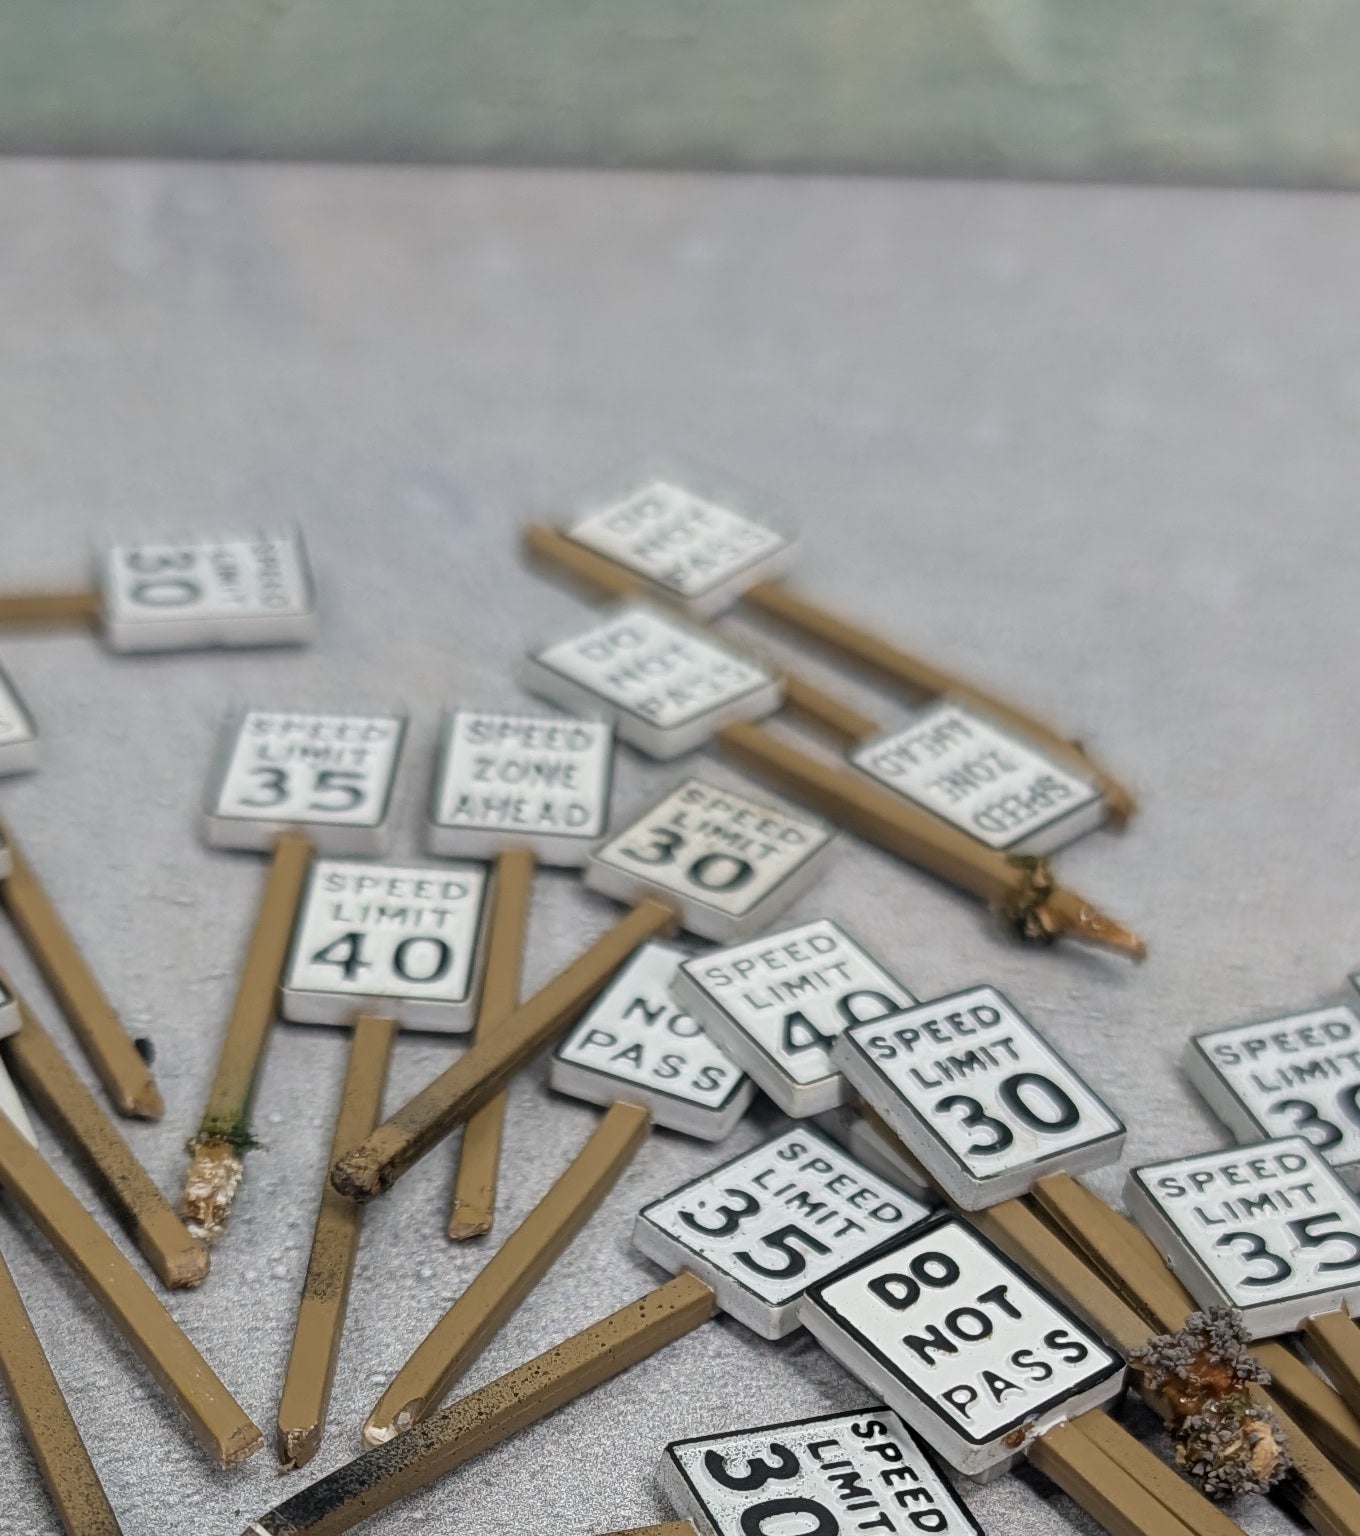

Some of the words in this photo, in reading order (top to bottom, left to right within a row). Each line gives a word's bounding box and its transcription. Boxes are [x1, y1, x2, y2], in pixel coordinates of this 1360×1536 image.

[580, 630, 643, 662] DO
[248, 716, 392, 745] SPEED
[257, 741, 371, 767] LIMIT
[465, 718, 594, 752] SPEED
[239, 767, 365, 811] 35
[474, 757, 582, 788] ZONE
[926, 750, 1018, 802] ZONE
[453, 791, 591, 829] AHEAD
[681, 786, 806, 846] SPEED
[973, 775, 1073, 833] SPEED
[619, 825, 757, 894] 30
[670, 809, 778, 861] LIMIT
[322, 872, 470, 900] SPEED
[336, 902, 453, 929] LIMIT
[311, 931, 452, 984] 40
[705, 935, 838, 987] SPEED
[742, 961, 851, 1010] LIMIT
[621, 998, 704, 1039] NO
[867, 1005, 1001, 1060] SPEED
[1215, 1021, 1351, 1066] SPEED
[578, 1029, 728, 1092] PASS
[909, 1037, 1020, 1090] LIMIT
[936, 1072, 1080, 1157] 30
[776, 1141, 904, 1225] SPEED
[1158, 1152, 1307, 1199] SPEED
[753, 1167, 866, 1240] LIMIT
[1194, 1182, 1315, 1226] LIMIT
[677, 1187, 831, 1280] 35
[867, 1251, 960, 1311] DO
[902, 1284, 1022, 1366] NOT
[941, 1329, 1089, 1420] PASS
[807, 1439, 898, 1534] LIMIT
[851, 1419, 949, 1534] SPEED
